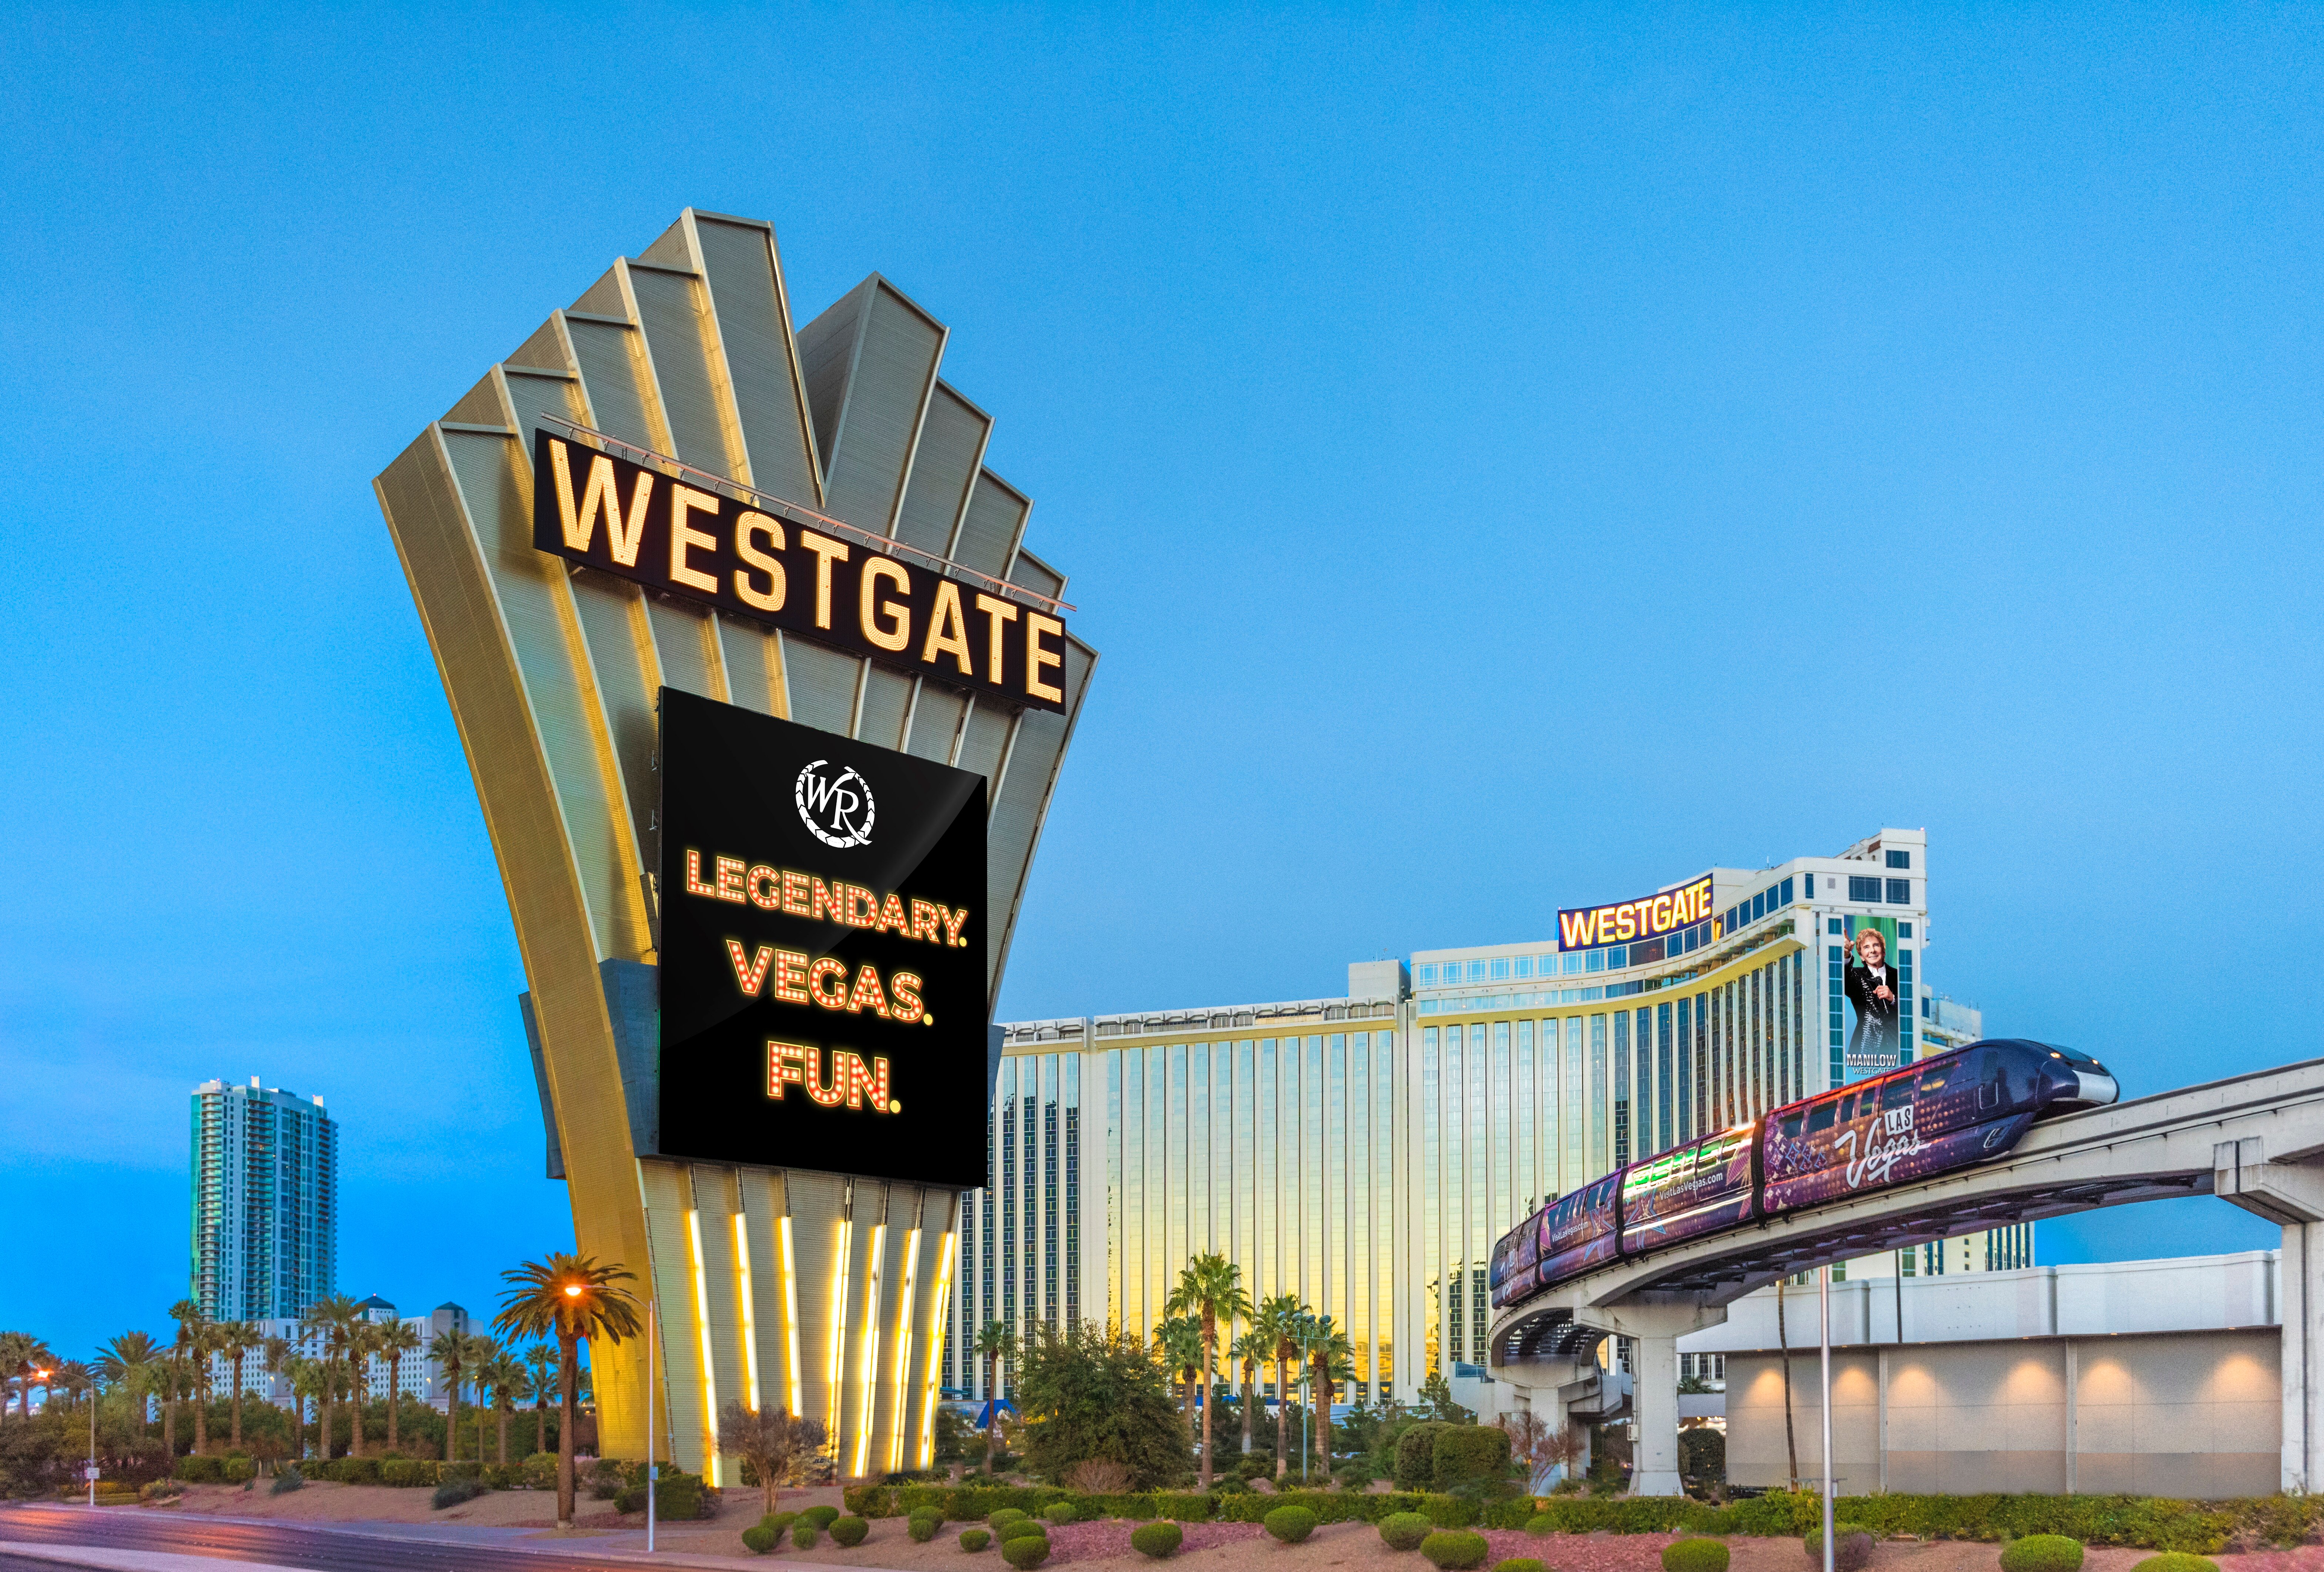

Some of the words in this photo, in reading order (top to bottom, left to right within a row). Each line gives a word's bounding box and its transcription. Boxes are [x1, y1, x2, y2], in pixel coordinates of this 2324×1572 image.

[549, 439, 1063, 704] WESTGATE
[687, 849, 969, 947] LEGENDARY.
[1560, 878, 1711, 948] WESTGATE
[726, 939, 933, 1026] VEGAS.
[767, 1040, 901, 1114] FUN.
[1846, 1054, 1897, 1067] MANILOW
[1835, 1117, 1932, 1188] Vegas
[1888, 1107, 1911, 1131] LAS
[1659, 1172, 1723, 1200] VisitLasVegas.com
[1552, 1221, 1588, 1243] VisitLasVegas.com
